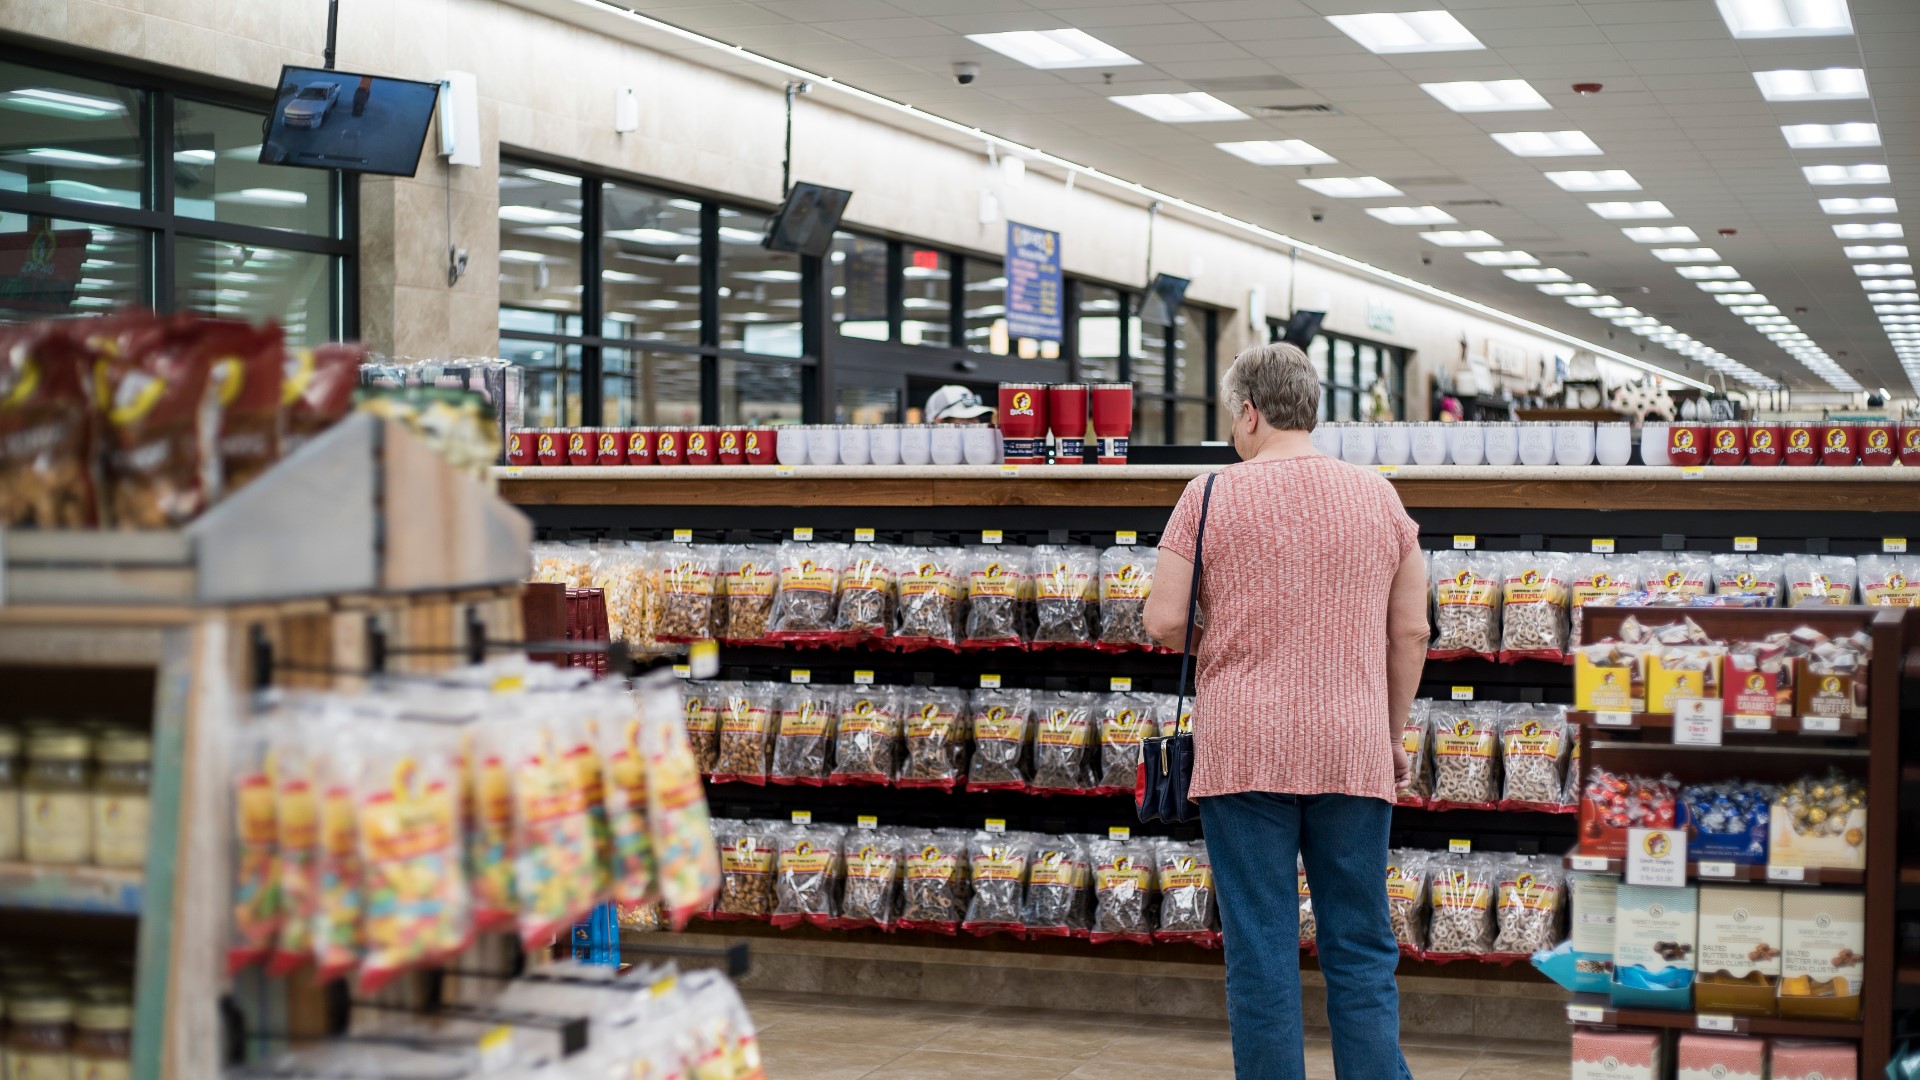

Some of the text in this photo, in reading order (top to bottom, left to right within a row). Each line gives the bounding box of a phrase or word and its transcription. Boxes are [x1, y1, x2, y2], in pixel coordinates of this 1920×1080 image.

[1737, 701, 1775, 712] CARAMELS
[1813, 704, 1850, 714] TRUFFLES
[1703, 944, 1728, 952] SALTED
[1703, 951, 1729, 959] BUTTER
[1785, 949, 1810, 958] SALTED
[1785, 957, 1828, 966] BUTTER RUM
[1785, 964, 1840, 974] PECAN CLUSTER
